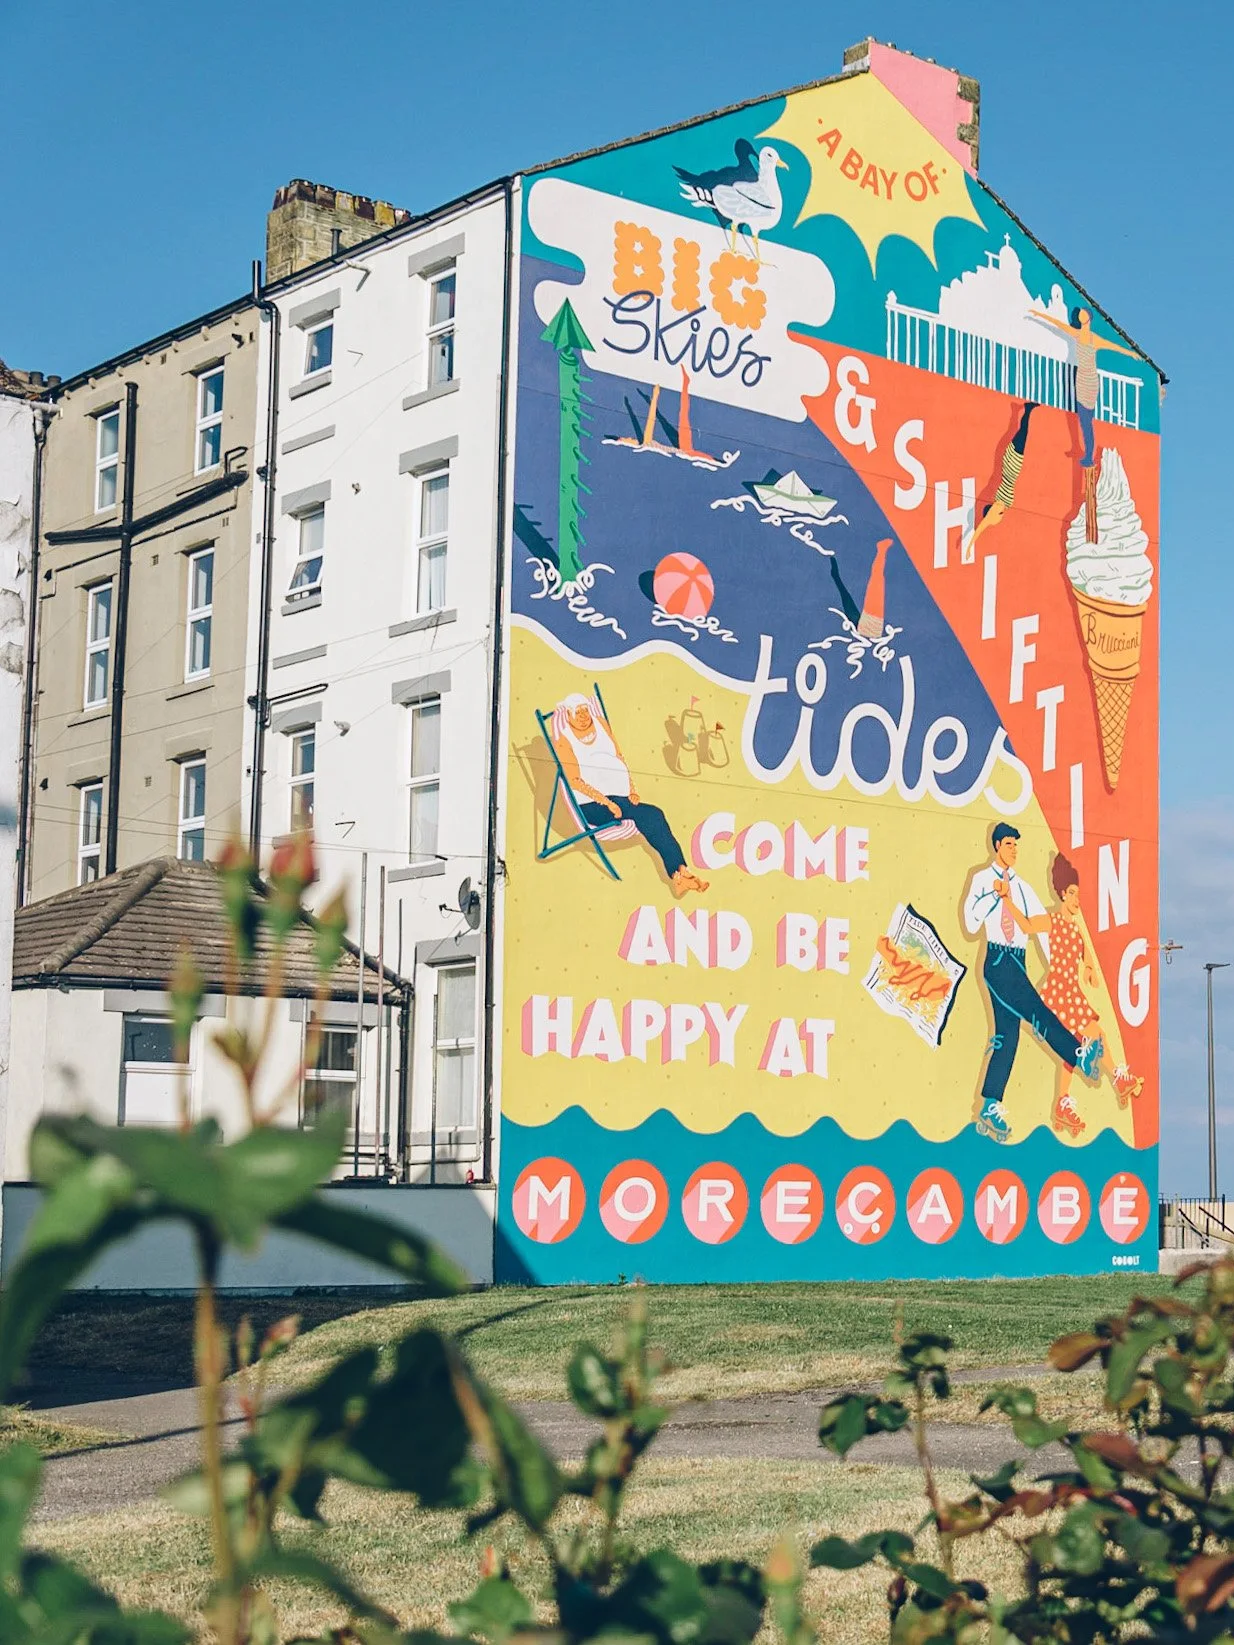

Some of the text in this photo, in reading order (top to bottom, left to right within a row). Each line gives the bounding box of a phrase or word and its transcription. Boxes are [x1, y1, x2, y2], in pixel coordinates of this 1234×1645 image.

[817, 128, 939, 202] A BAY OF
[613, 220, 767, 331] BIG
[603, 290, 772, 387] Skies
[1081, 611, 1140, 654] Brucciani
[741, 635, 1034, 816] tides
[835, 355, 1150, 1027] & SHIFTING
[691, 812, 870, 884] COME
[618, 905, 850, 976] AND BE
[521, 995, 836, 1080] HAPPY AT
[527, 1175, 1140, 1225] MORECAMBE
